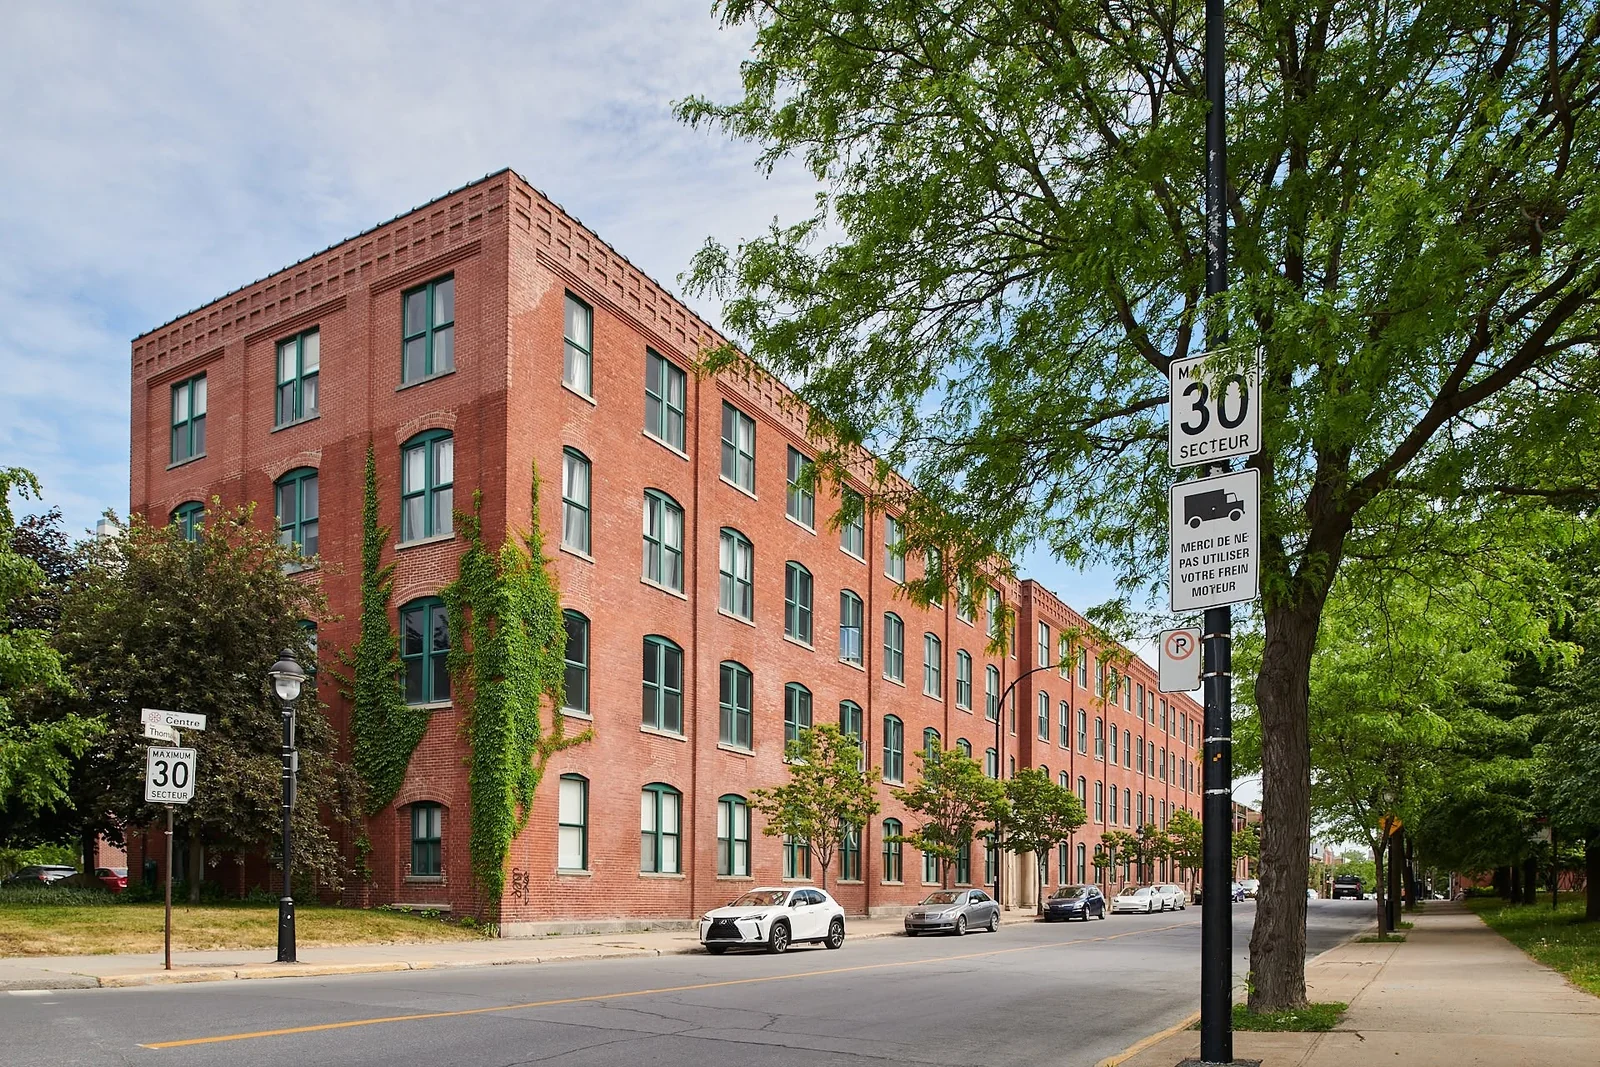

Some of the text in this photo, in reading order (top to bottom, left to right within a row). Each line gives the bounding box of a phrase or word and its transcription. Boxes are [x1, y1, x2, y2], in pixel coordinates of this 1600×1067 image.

[1180, 373, 1249, 436] 30
[1180, 434, 1249, 459] SECTEUR
[1181, 532, 1248, 553] MERCI DE NE
[1179, 548, 1250, 569] PAS UTILISER
[1181, 563, 1249, 584] VOTRE FREIN
[1192, 581, 1236, 598] MOTEUR
[165, 716, 200, 727] Centre
[152, 750, 191, 760] MAXIMUM
[152, 759, 189, 789] 30
[151, 790, 188, 799] SECTEUR
